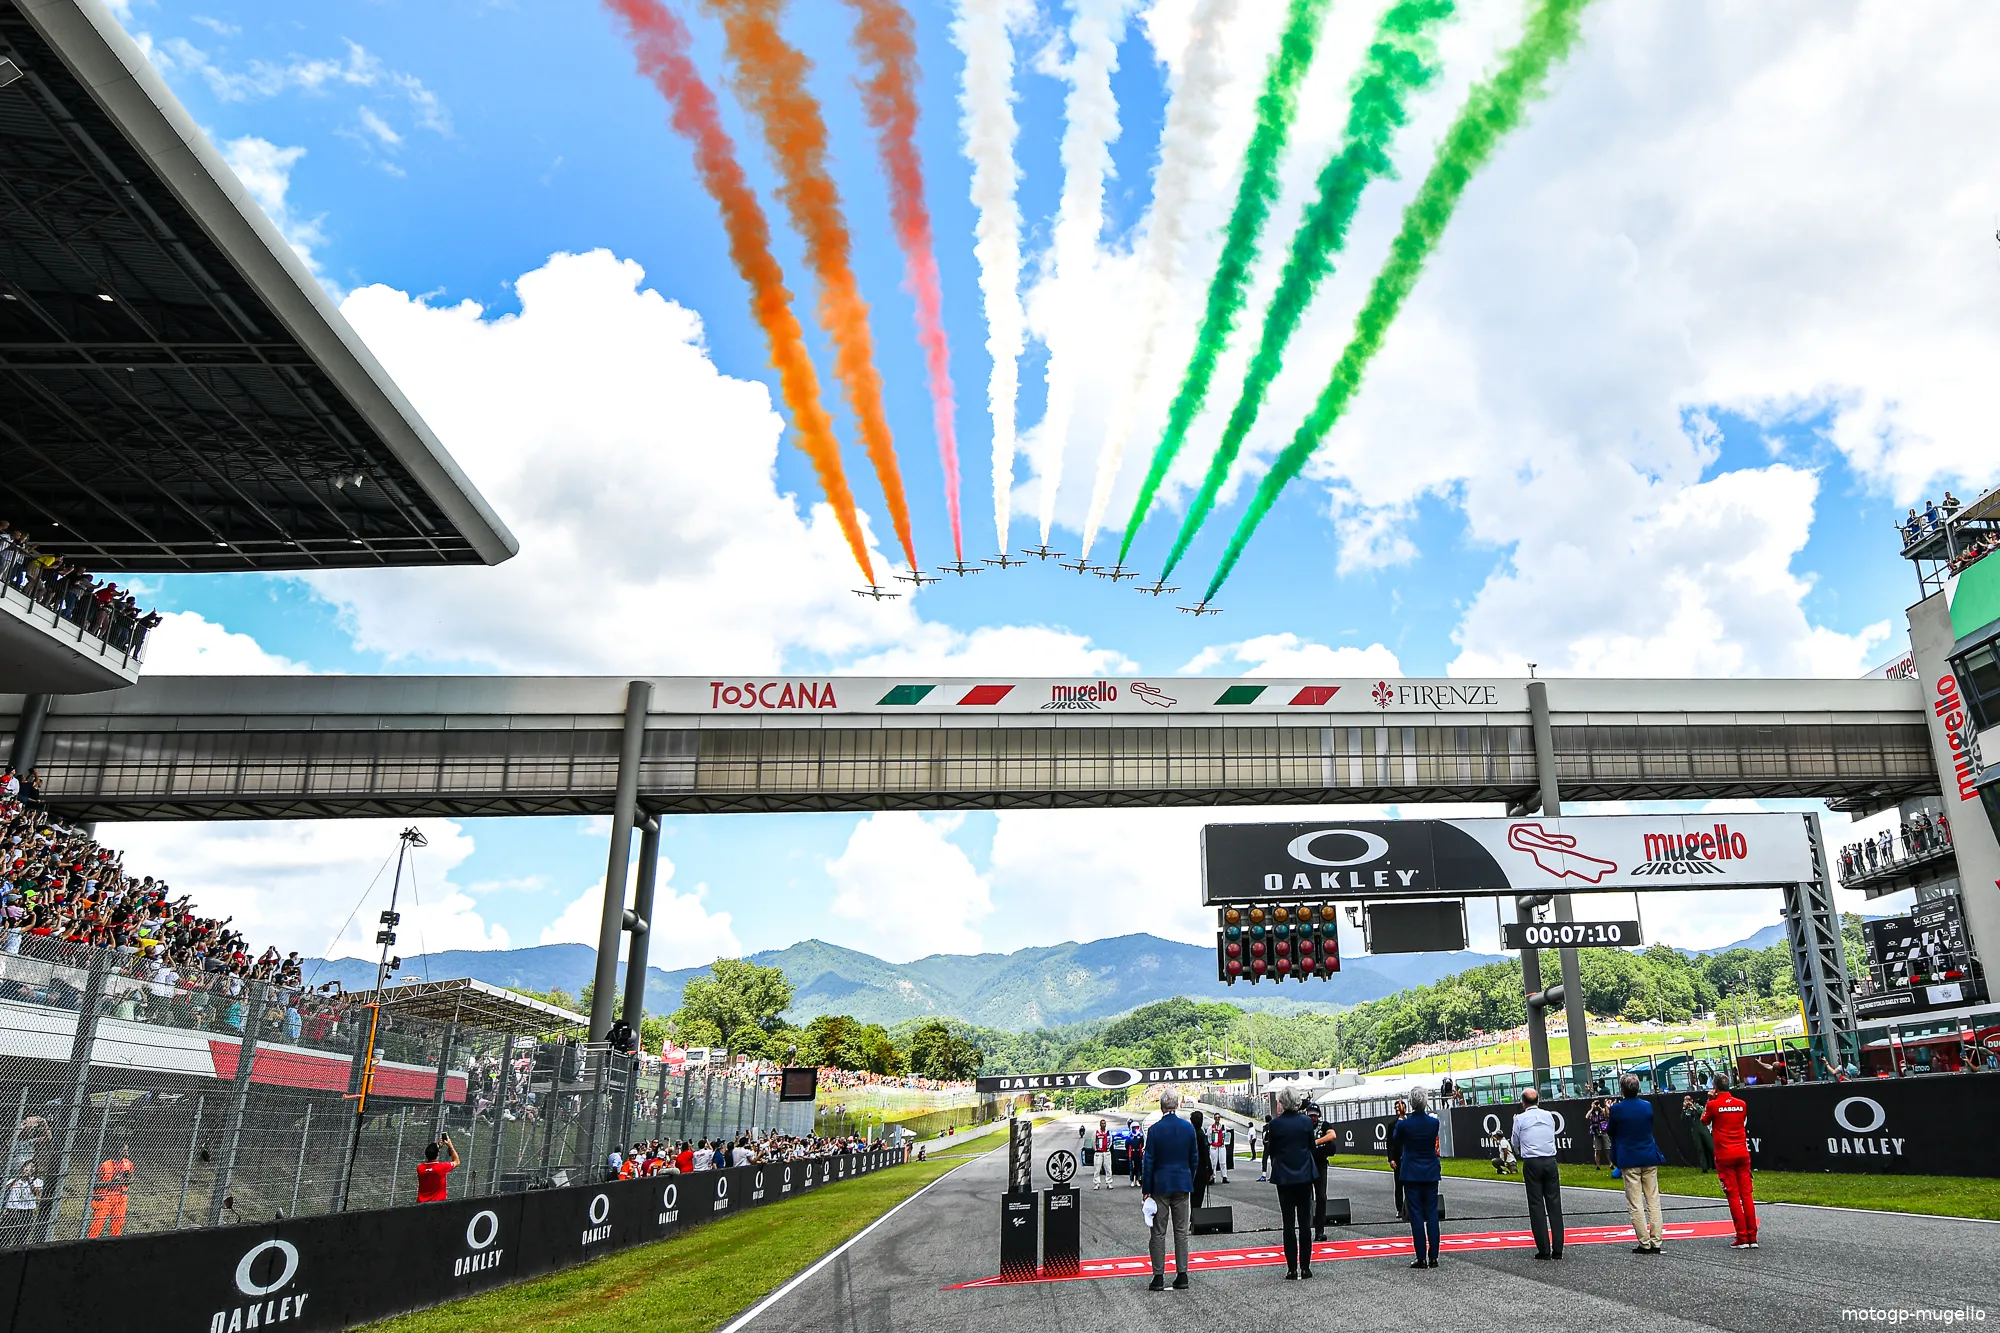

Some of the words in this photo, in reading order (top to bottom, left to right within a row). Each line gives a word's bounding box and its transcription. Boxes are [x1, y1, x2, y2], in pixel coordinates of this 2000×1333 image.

[710, 681, 837, 709] TOSCANA
[1052, 681, 1118, 702] mugello
[1398, 684, 1498, 710] FIRENZE
[1934, 674, 1979, 801] mugello
[1643, 823, 1748, 861] mugello
[1630, 861, 1726, 876] CIRCUIT
[1264, 868, 1419, 892] OAKLEY
[1524, 924, 1621, 945] 00:07:10
[1000, 1074, 1081, 1090] OAKLEY
[1150, 1067, 1229, 1082] OAKLEY
[1827, 1137, 1906, 1156] OAKLEY
[658, 1210, 679, 1225] OAKLEY
[582, 1225, 612, 1245] OAKLEY
[454, 1249, 503, 1277] OAKLEY
[210, 1293, 309, 1333] OAKLEY
